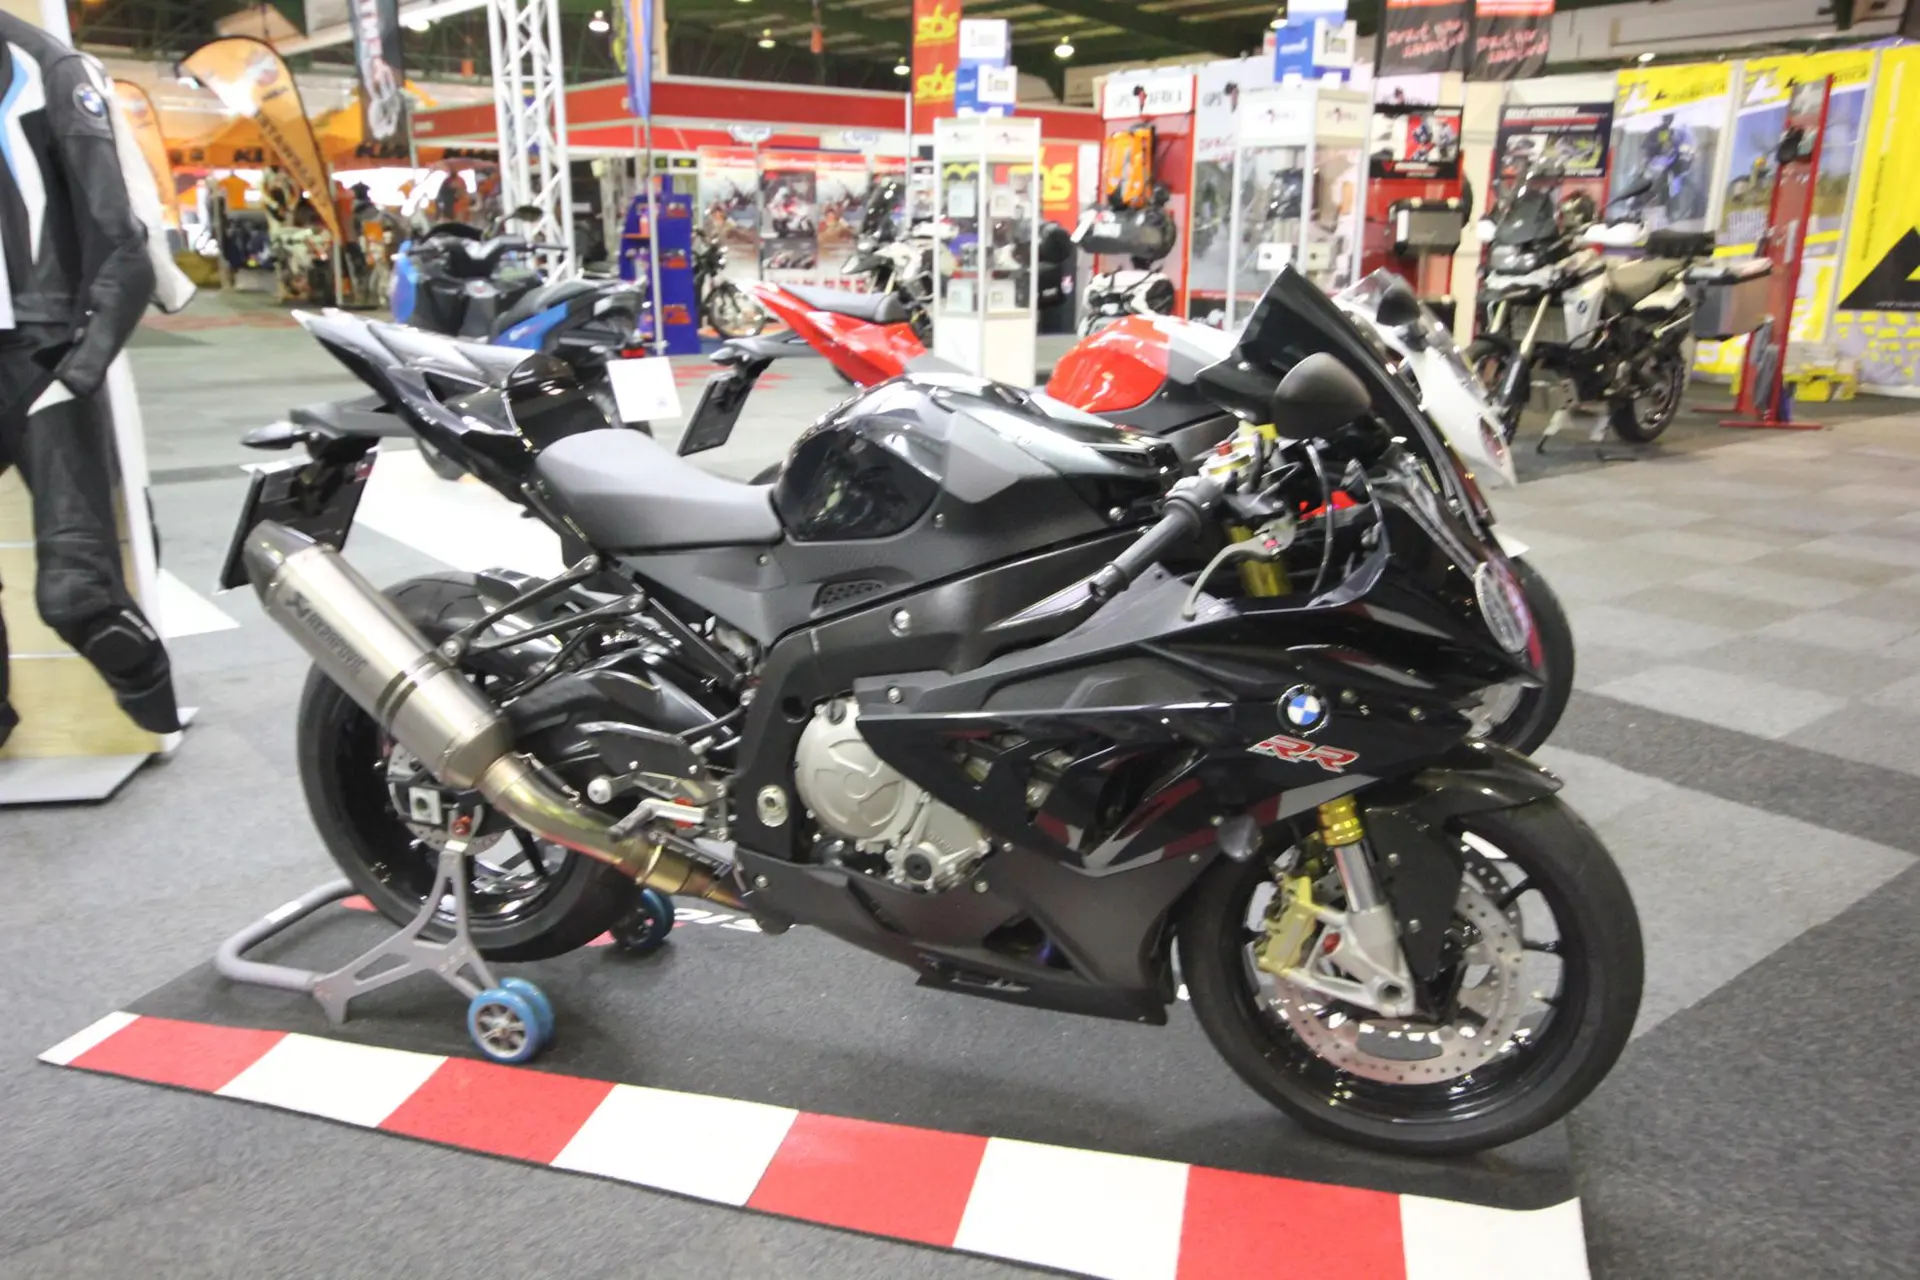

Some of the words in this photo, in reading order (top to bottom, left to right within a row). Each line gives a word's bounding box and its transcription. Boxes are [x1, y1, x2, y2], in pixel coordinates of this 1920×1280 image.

[915, 4, 959, 42] sbs
[914, 63, 956, 99] sbs
[1246, 735, 1360, 773] RR
